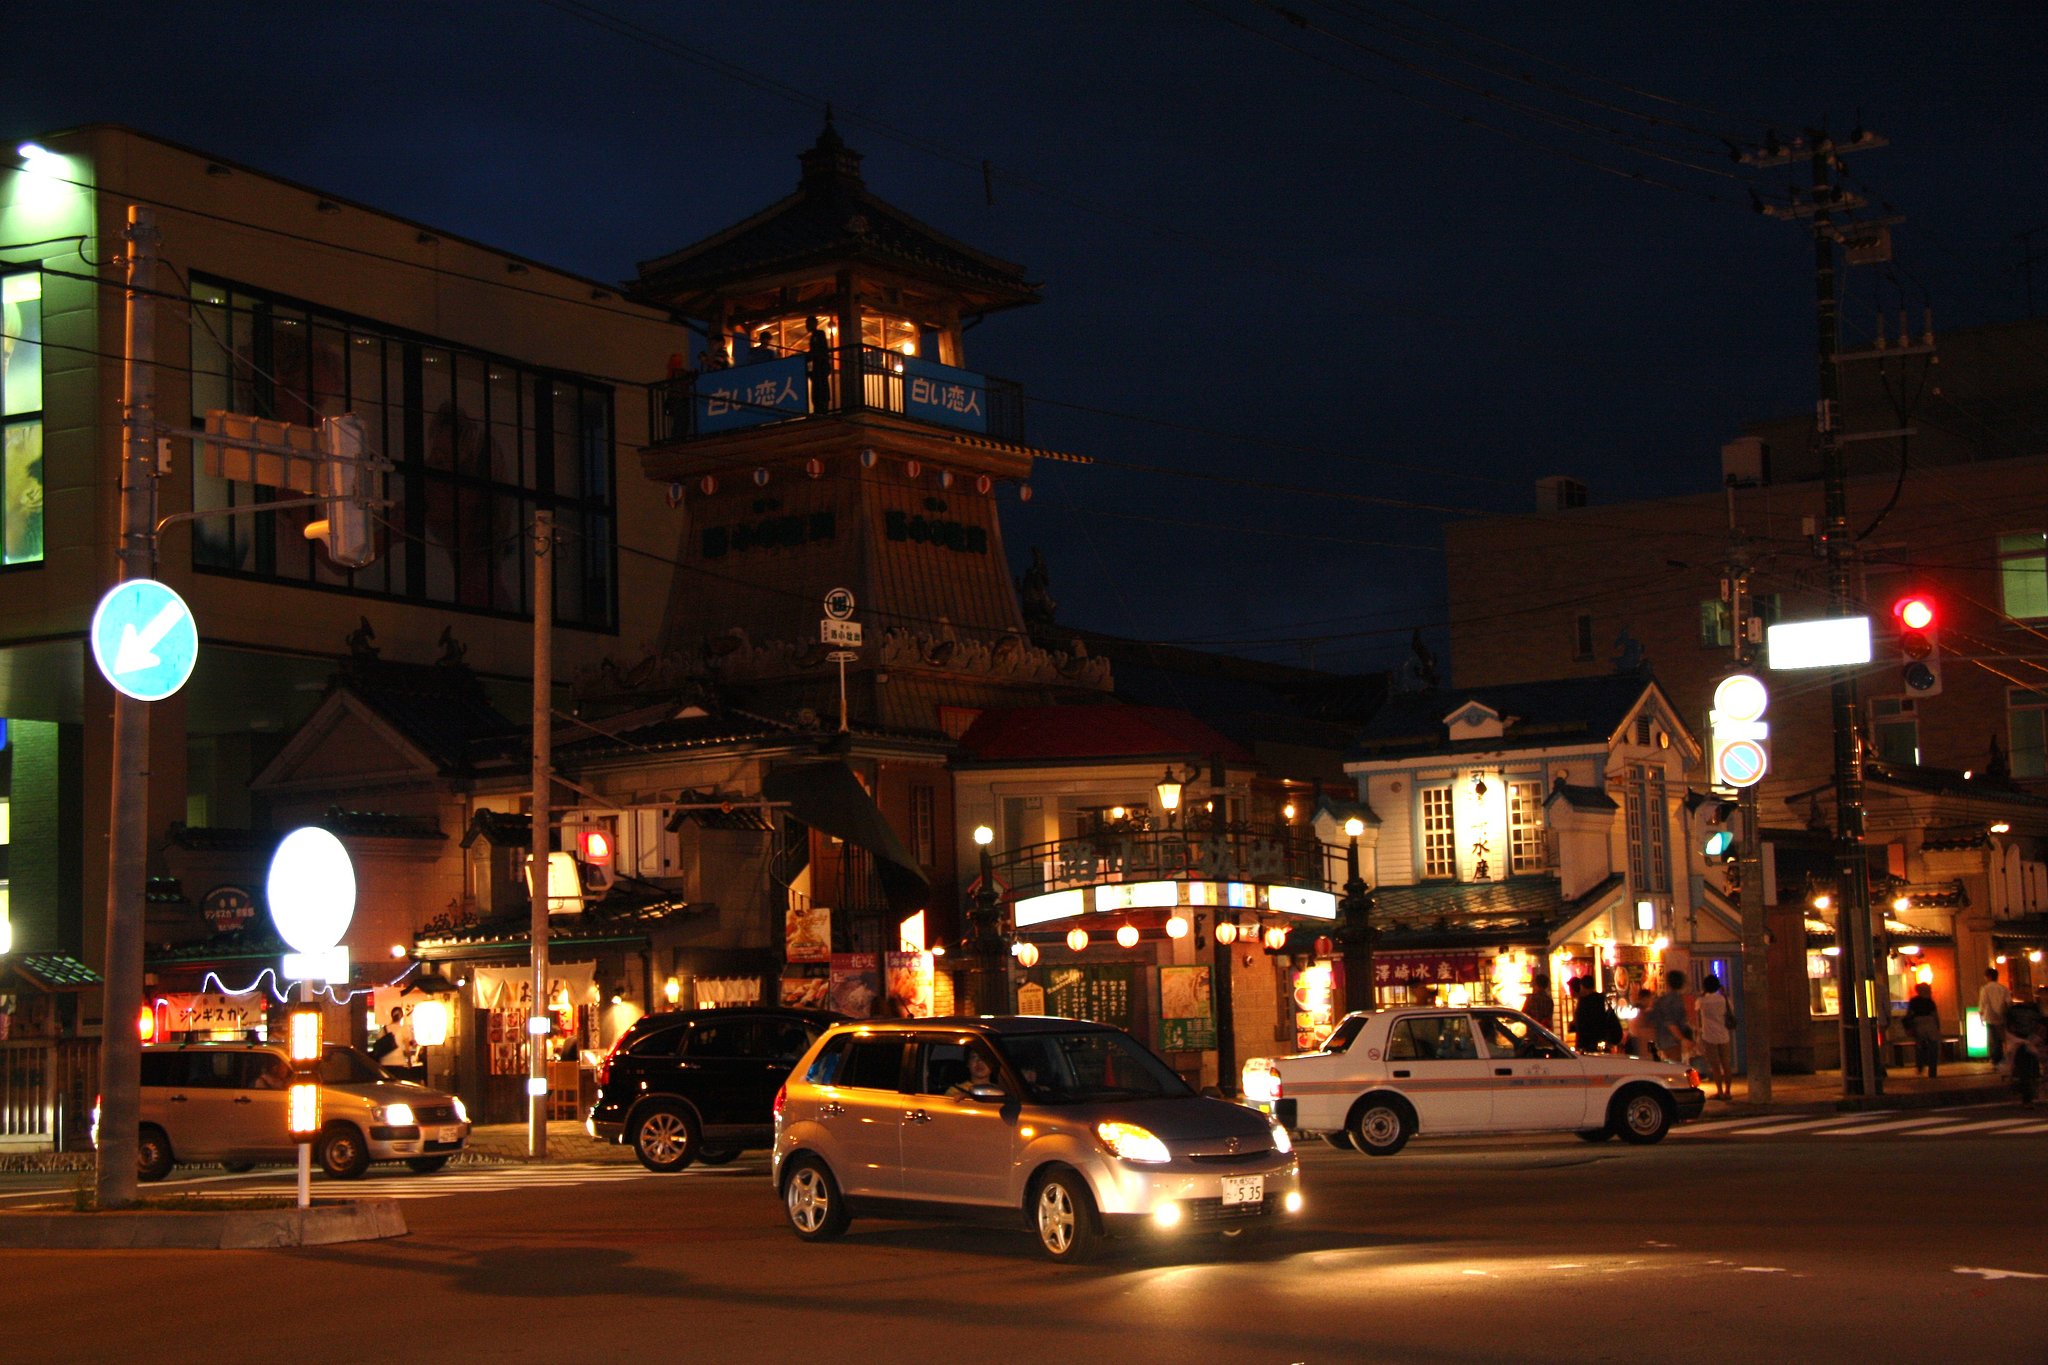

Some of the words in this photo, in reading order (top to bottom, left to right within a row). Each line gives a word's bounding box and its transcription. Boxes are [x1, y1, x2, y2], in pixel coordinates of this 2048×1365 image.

[707, 376, 799, 417] 白い恋人
[911, 378, 981, 417] 白い恋人
[179, 1007, 249, 1023] ジンギスカン
